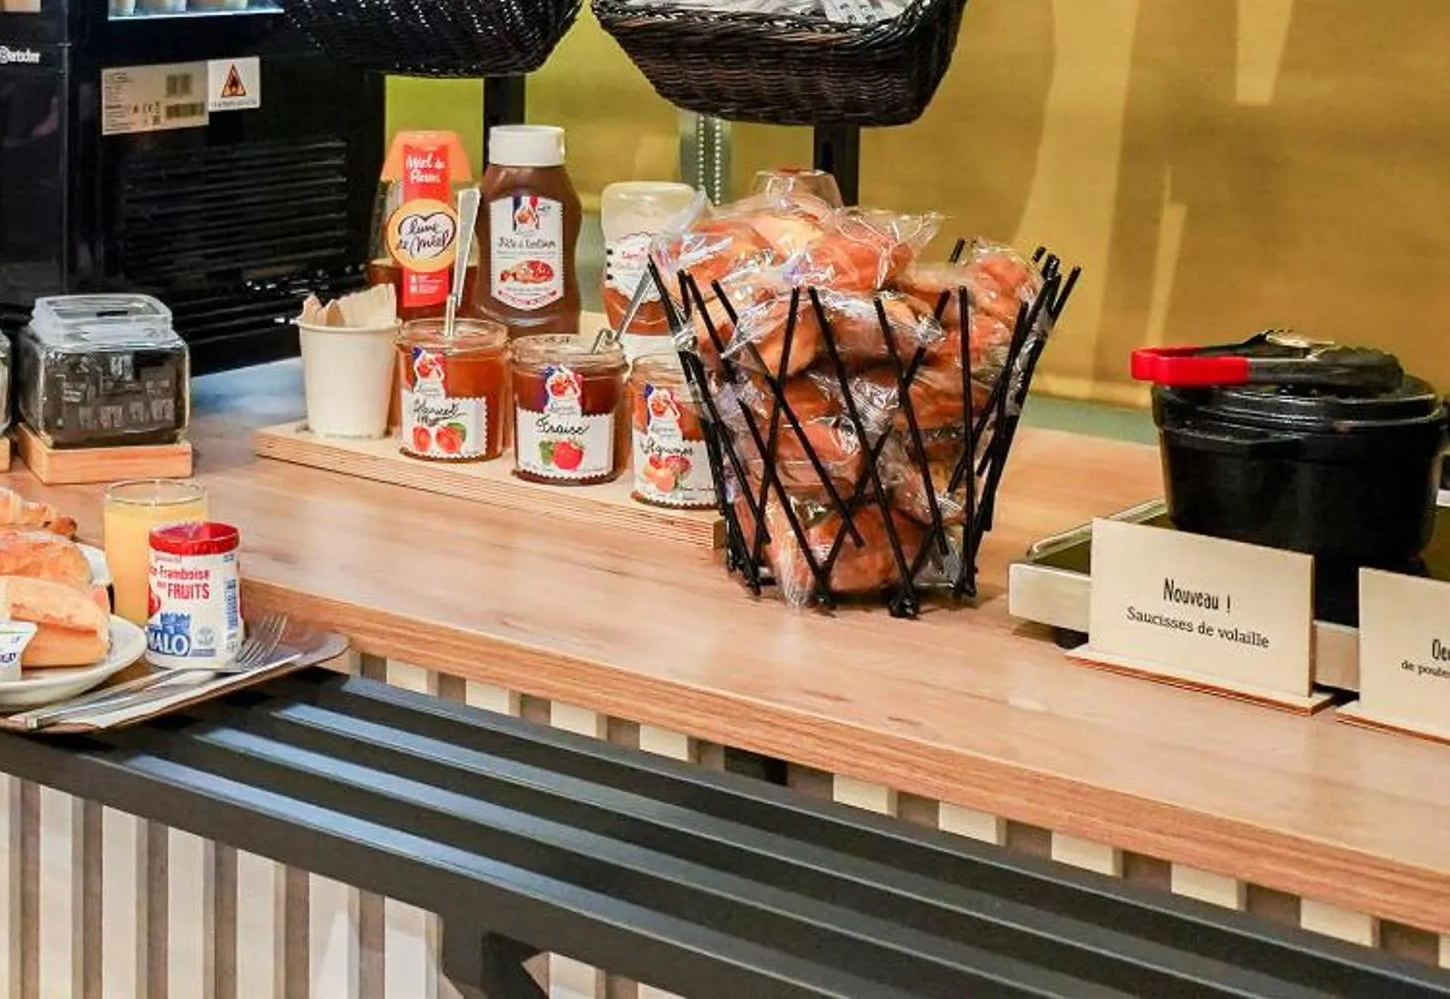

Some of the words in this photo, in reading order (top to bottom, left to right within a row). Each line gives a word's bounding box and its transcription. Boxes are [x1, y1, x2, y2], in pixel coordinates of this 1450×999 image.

[168, 583, 210, 600] FRUITS
[1163, 578, 1219, 610] Nouveau
[1226, 594, 1231, 613] !
[1127, 605, 1193, 632] Saucisses
[1198, 621, 1214, 636] de
[1217, 628, 1270, 648] volaille
[1401, 660, 1415, 671] de
